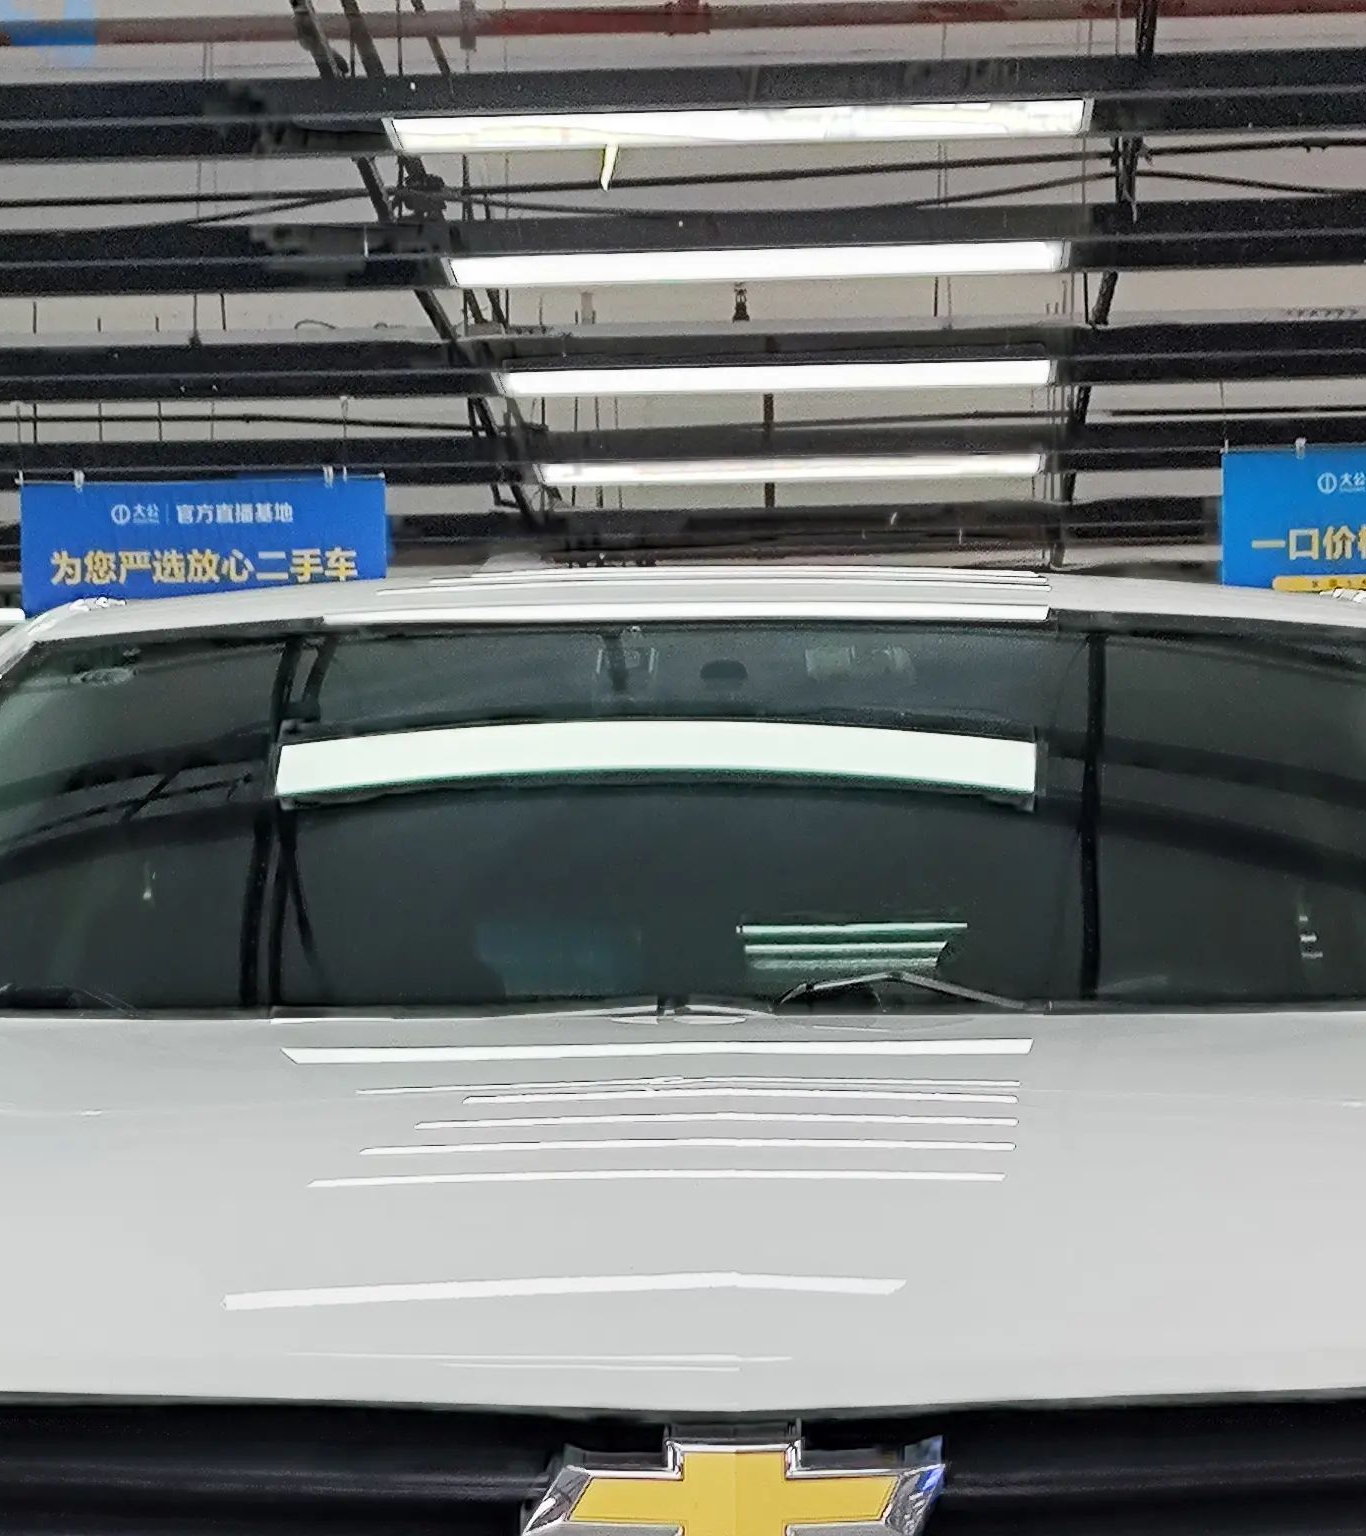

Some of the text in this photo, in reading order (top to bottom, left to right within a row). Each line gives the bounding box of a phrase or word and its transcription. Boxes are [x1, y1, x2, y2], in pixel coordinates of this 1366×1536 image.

[50, 547, 358, 585] 为您严选放心二手车
